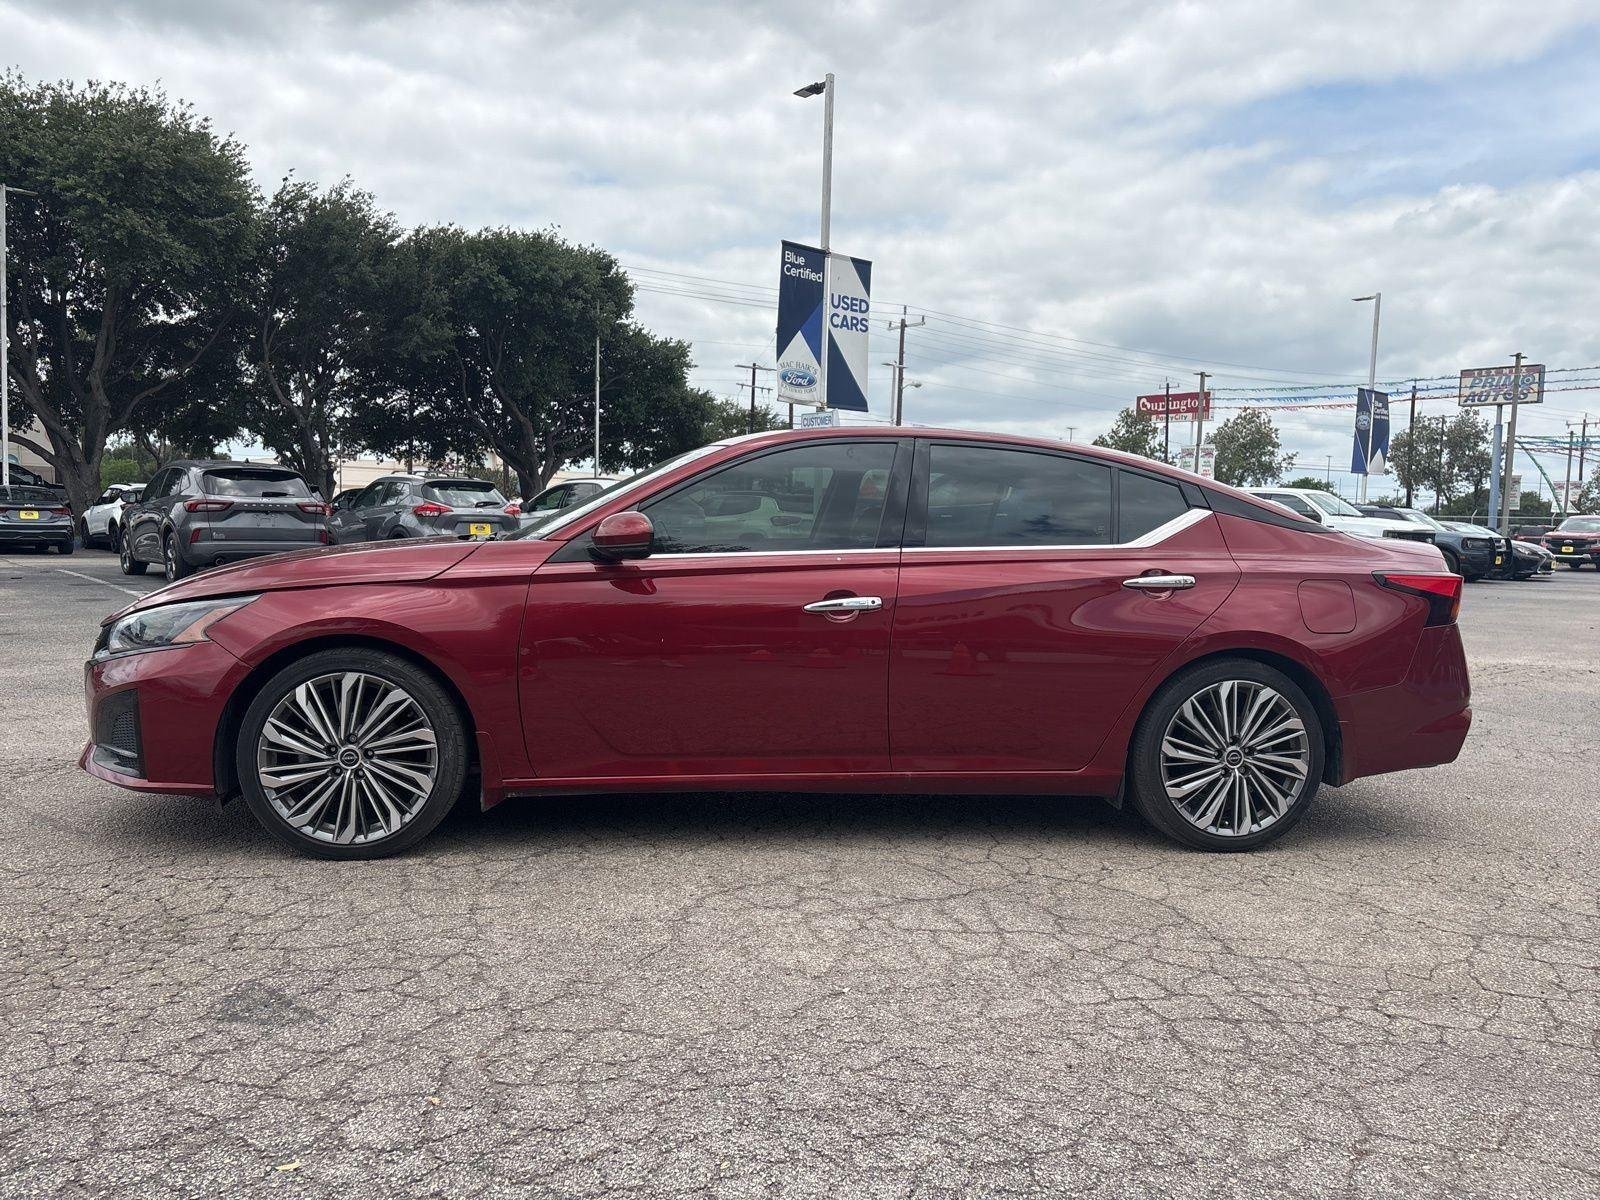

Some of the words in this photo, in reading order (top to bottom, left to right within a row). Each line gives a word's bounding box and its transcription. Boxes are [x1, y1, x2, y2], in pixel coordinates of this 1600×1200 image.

[784, 250, 805, 265] Blue
[783, 264, 823, 282] Certified
[831, 292, 870, 313] USED
[830, 312, 869, 333] CARS
[785, 371, 810, 386] Ford
[1473, 368, 1497, 377] TEX
[1462, 389, 1528, 404] AUTOS
[802, 416, 832, 427] CUSTOMER
[1155, 414, 1174, 422] Pary
[1174, 413, 1188, 421] City
